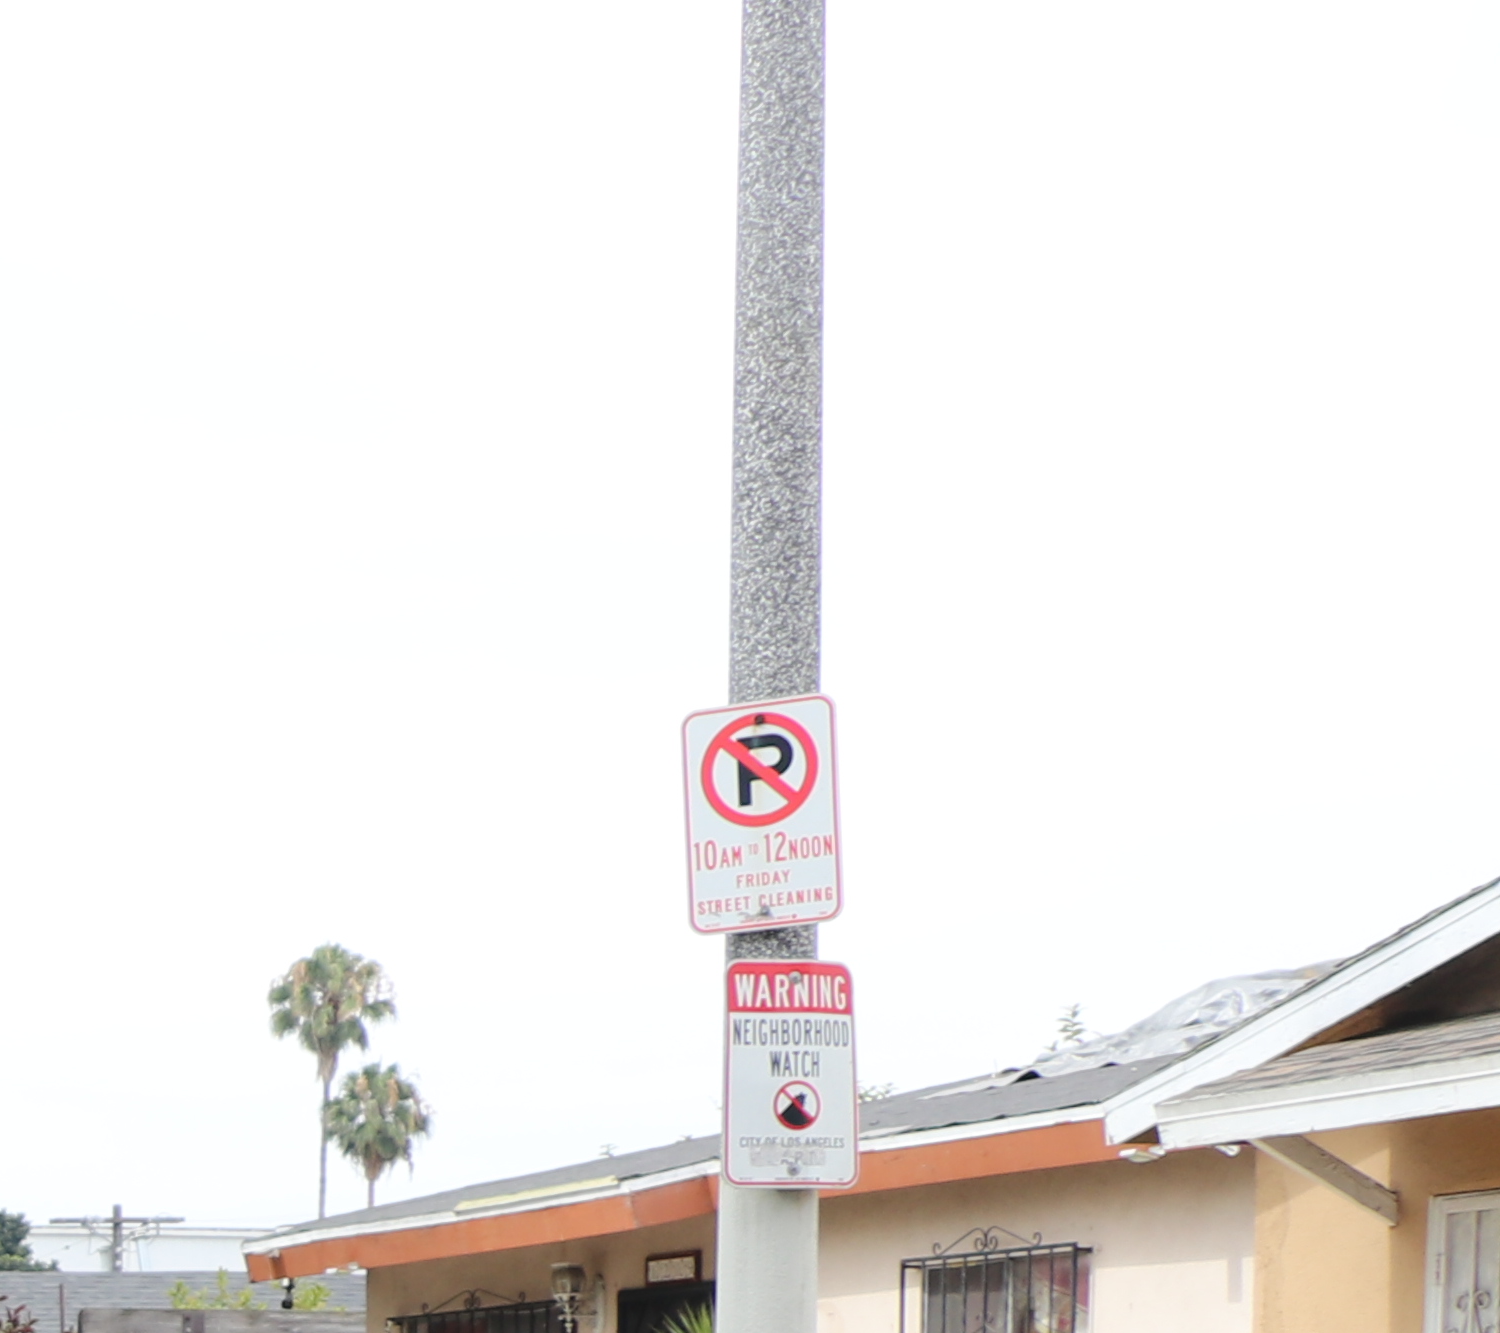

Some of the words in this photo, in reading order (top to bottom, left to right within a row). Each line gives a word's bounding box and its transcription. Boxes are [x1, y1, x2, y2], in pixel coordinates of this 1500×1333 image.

[694, 840, 743, 871] 10AM
[764, 831, 833, 863] 12NOON
[736, 869, 791, 888] FRIDAY
[698, 895, 752, 915] STREET
[759, 886, 834, 908] CLEANING
[734, 973, 847, 1010] WARNING
[733, 1018, 849, 1047] NEIGHBORHOOD
[769, 1051, 820, 1078] WATCH
[804, 1137, 845, 1149] ANGELES
